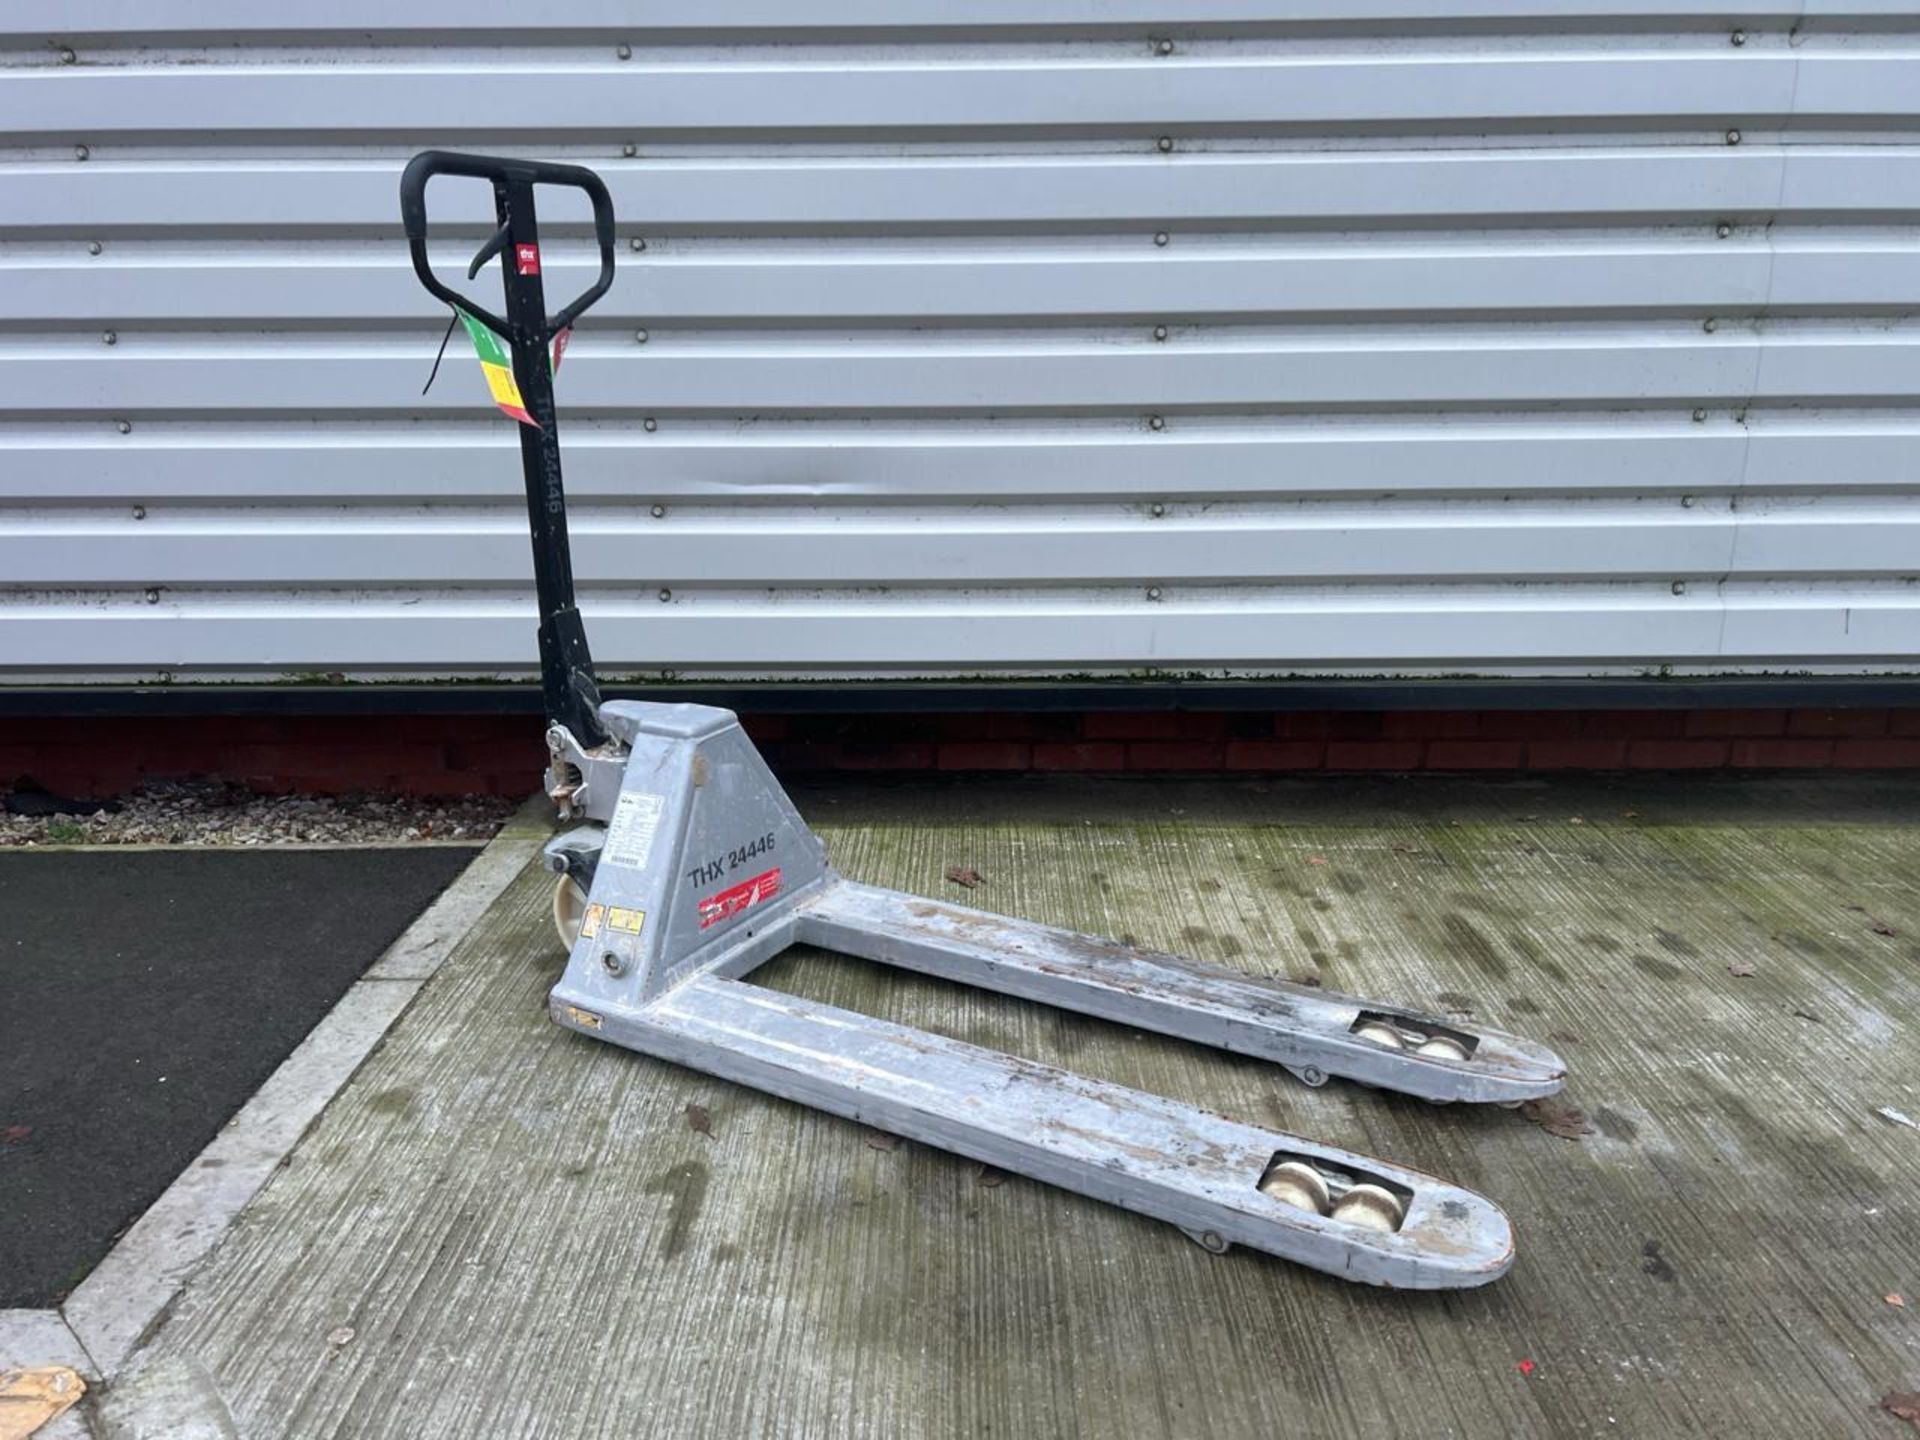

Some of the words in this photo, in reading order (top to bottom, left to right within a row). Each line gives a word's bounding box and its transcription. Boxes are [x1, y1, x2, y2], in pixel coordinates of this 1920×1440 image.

[543, 446, 563, 514] 24446
[687, 856, 724, 888] THX
[728, 832, 775, 869] 24446
